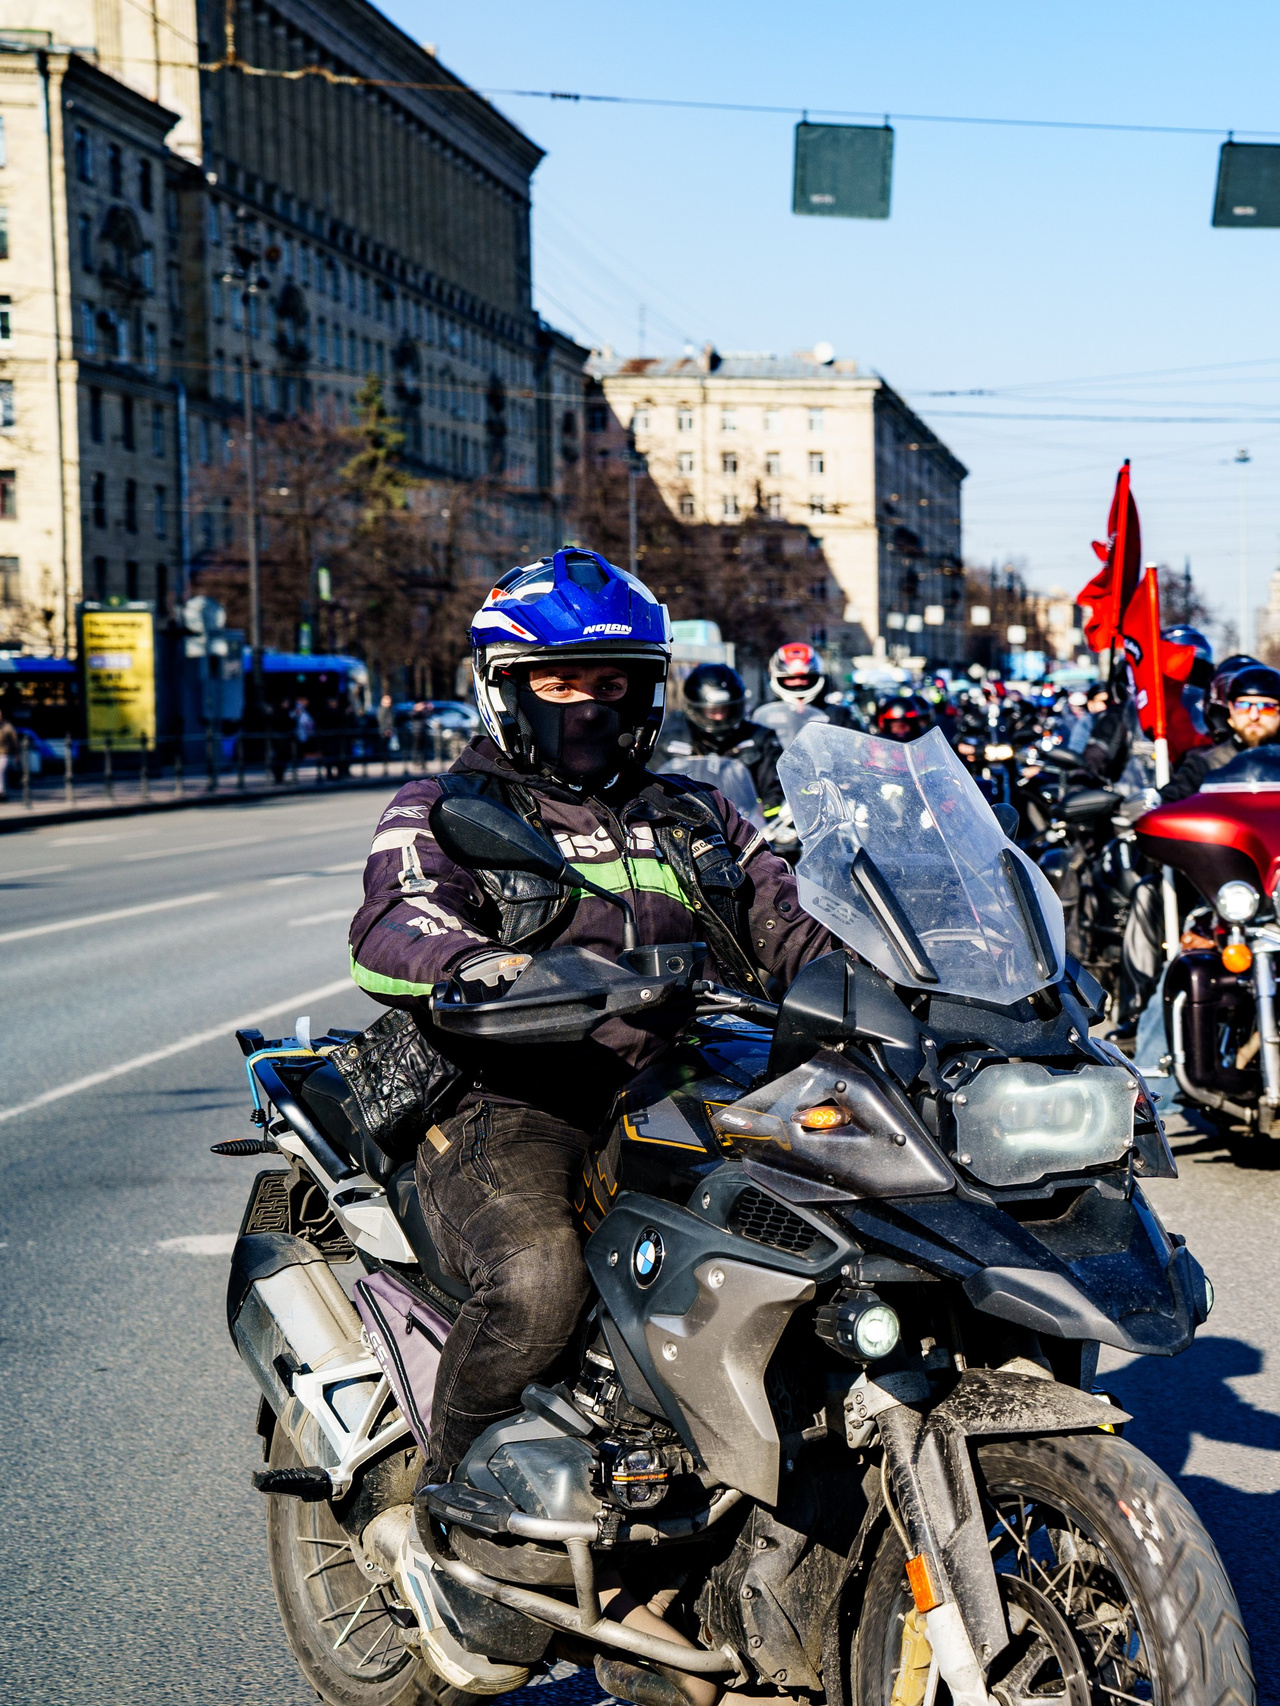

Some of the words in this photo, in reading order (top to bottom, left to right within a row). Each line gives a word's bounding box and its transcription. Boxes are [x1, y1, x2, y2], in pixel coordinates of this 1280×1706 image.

[583, 623, 632, 635] NOLAN
[499, 957, 524, 970] MCP
[641, 1232, 662, 1256] BMW
[370, 1331, 388, 1364] GS
